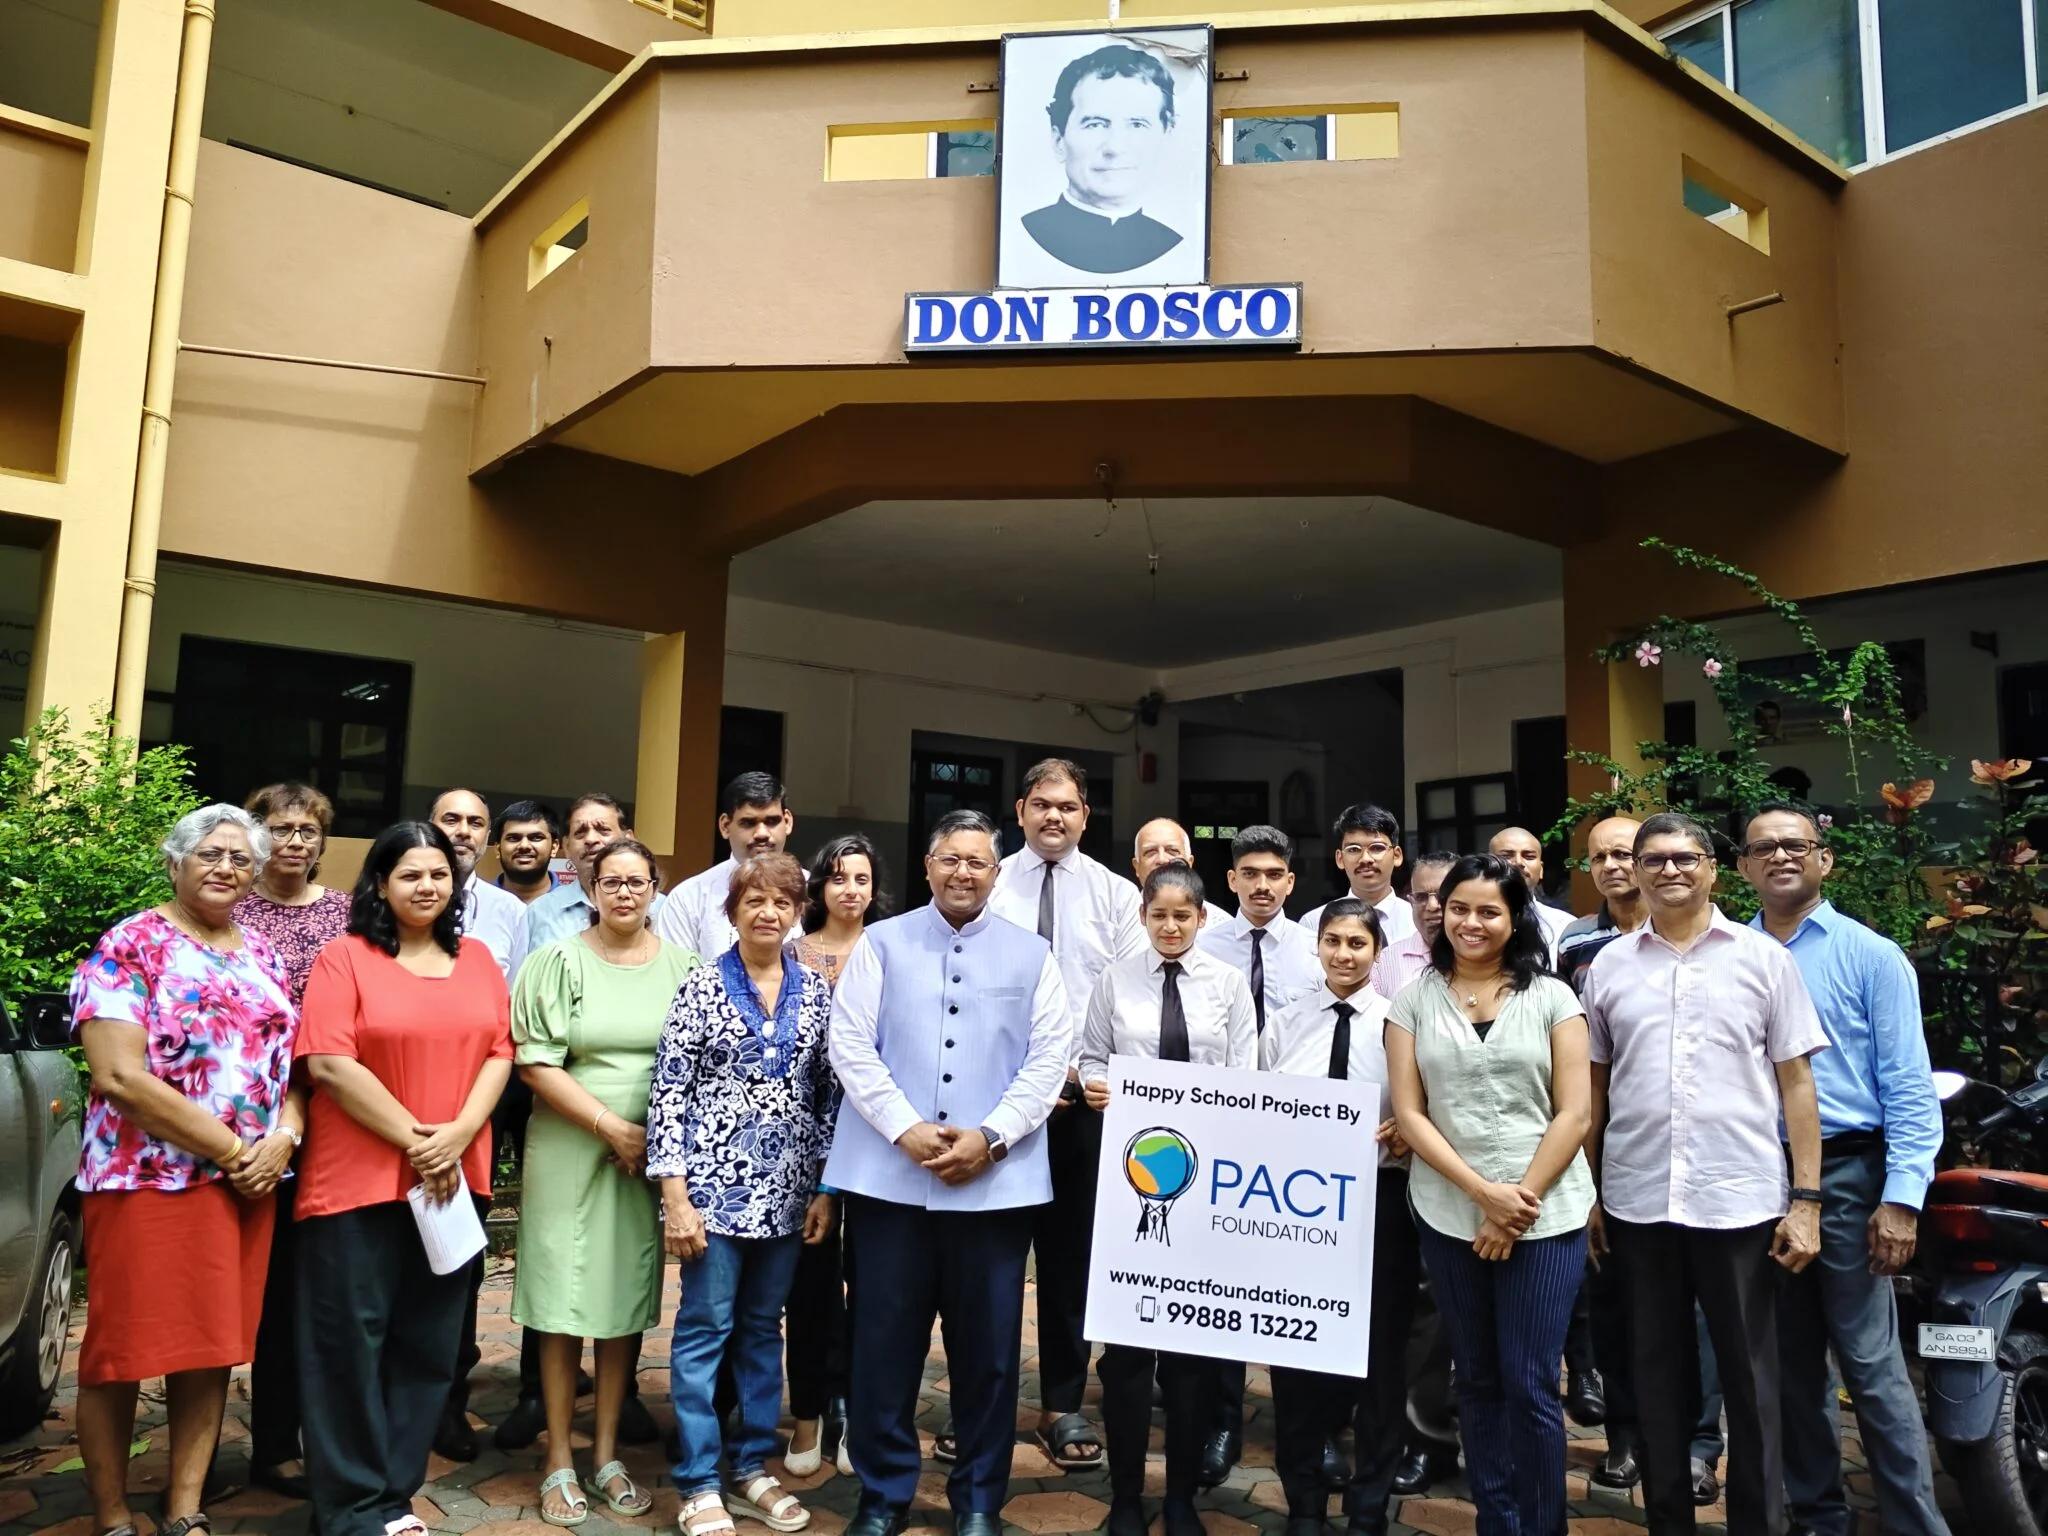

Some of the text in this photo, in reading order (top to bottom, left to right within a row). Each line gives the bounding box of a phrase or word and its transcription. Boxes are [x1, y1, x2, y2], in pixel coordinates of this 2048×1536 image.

[913, 288, 1292, 344] DON BOSCO
[1122, 1079, 1361, 1126] Happy School Project By
[1210, 1158, 1356, 1222] PACT
[1211, 1215, 1338, 1247] FOUNDATION
[1109, 1269, 1350, 1317] www.pactfoundation.org
[1166, 1301, 1319, 1343] 99888 13222
[1935, 1332, 1976, 1343] GA 03
[1924, 1344, 1988, 1355] AN 5994
